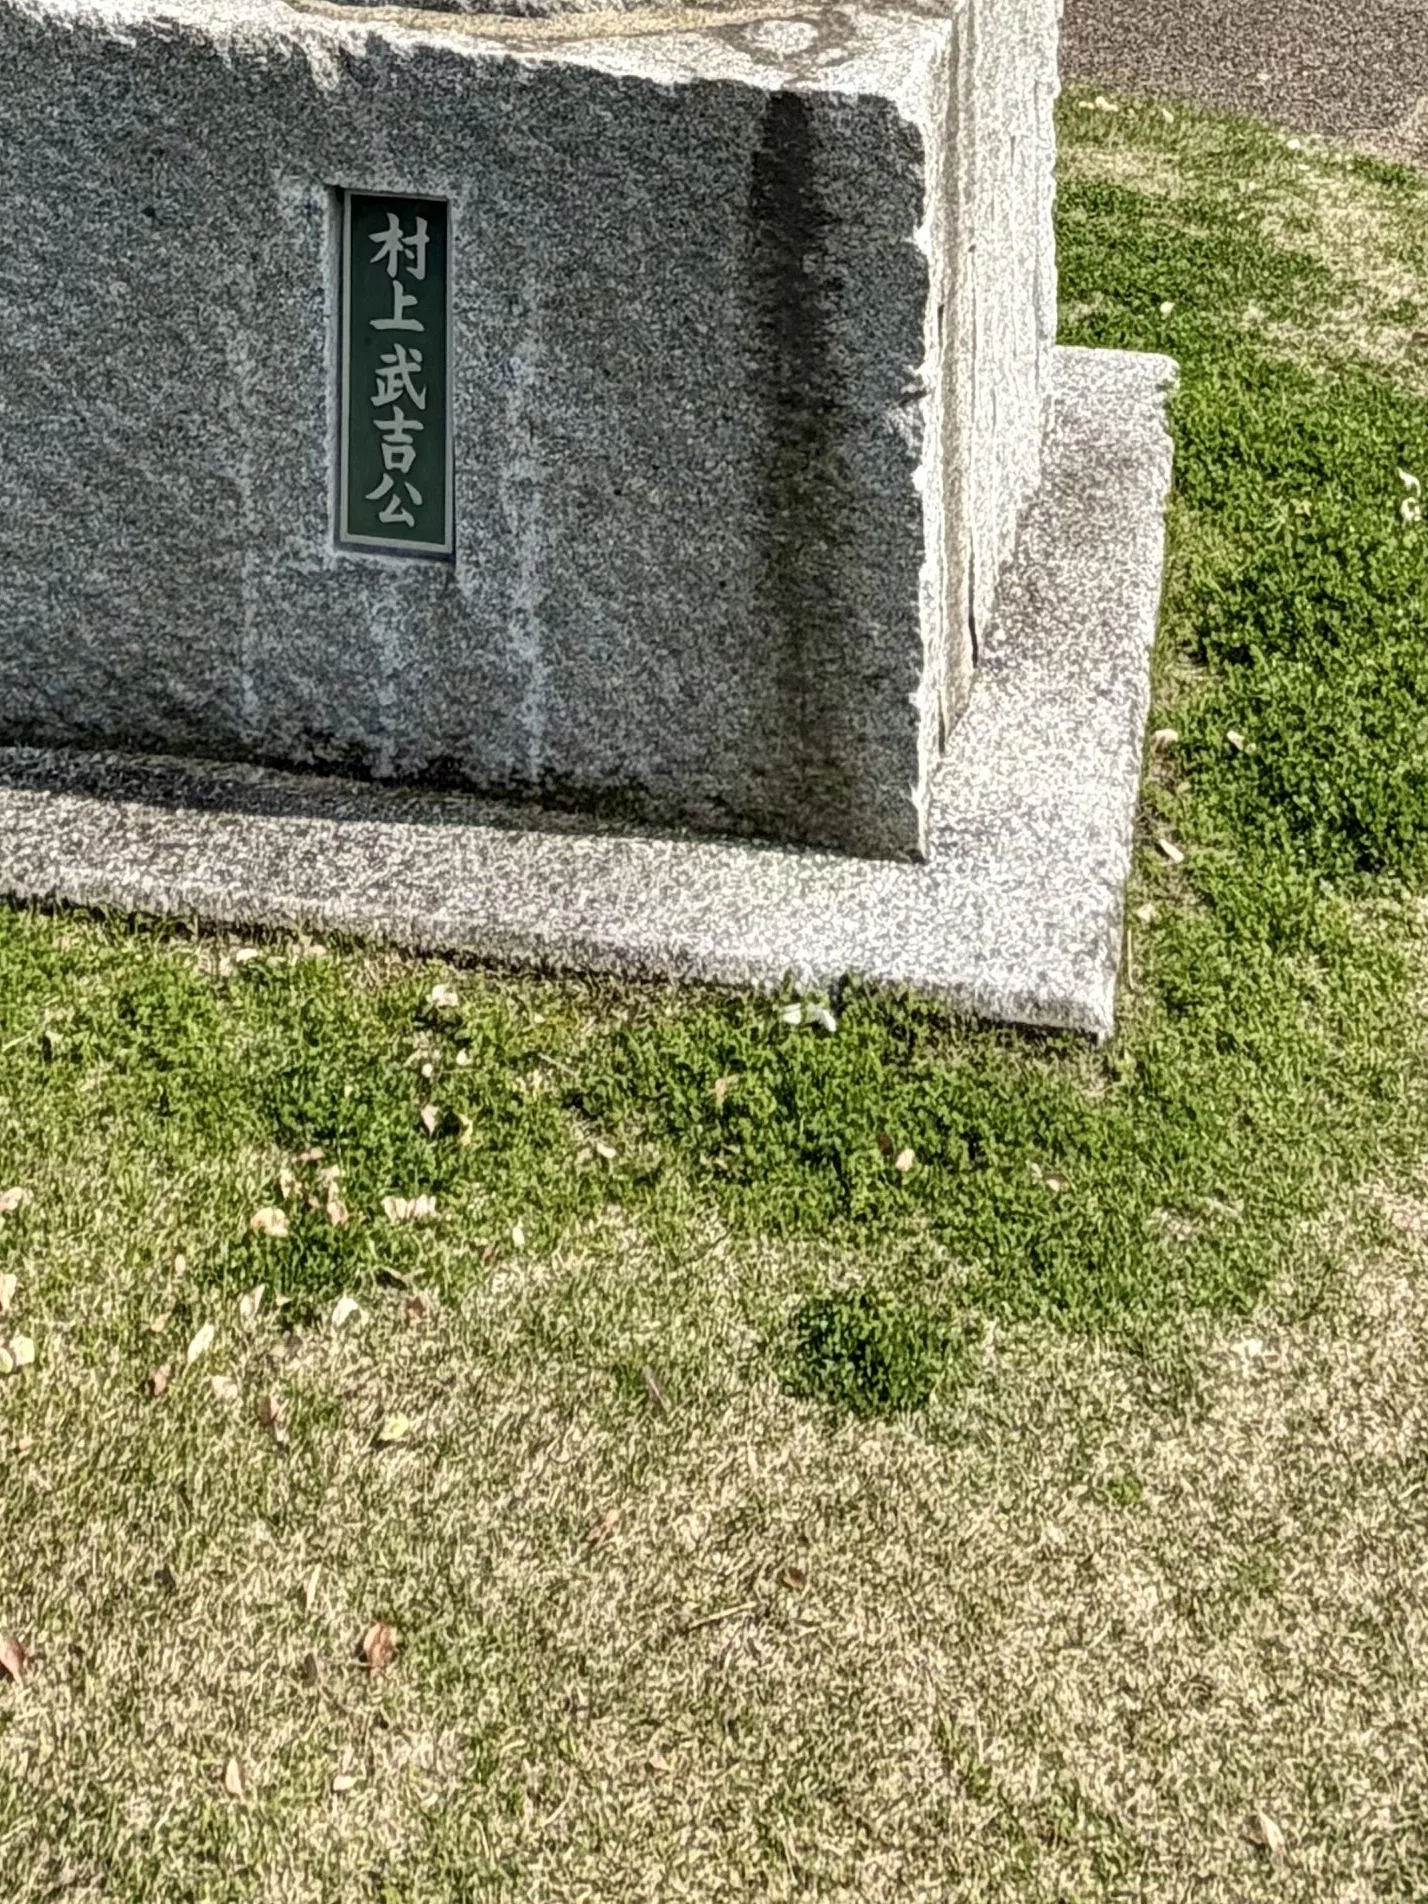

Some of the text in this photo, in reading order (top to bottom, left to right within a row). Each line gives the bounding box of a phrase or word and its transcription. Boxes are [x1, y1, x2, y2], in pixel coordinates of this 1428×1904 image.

[365, 212, 430, 528] 村上武吉公
